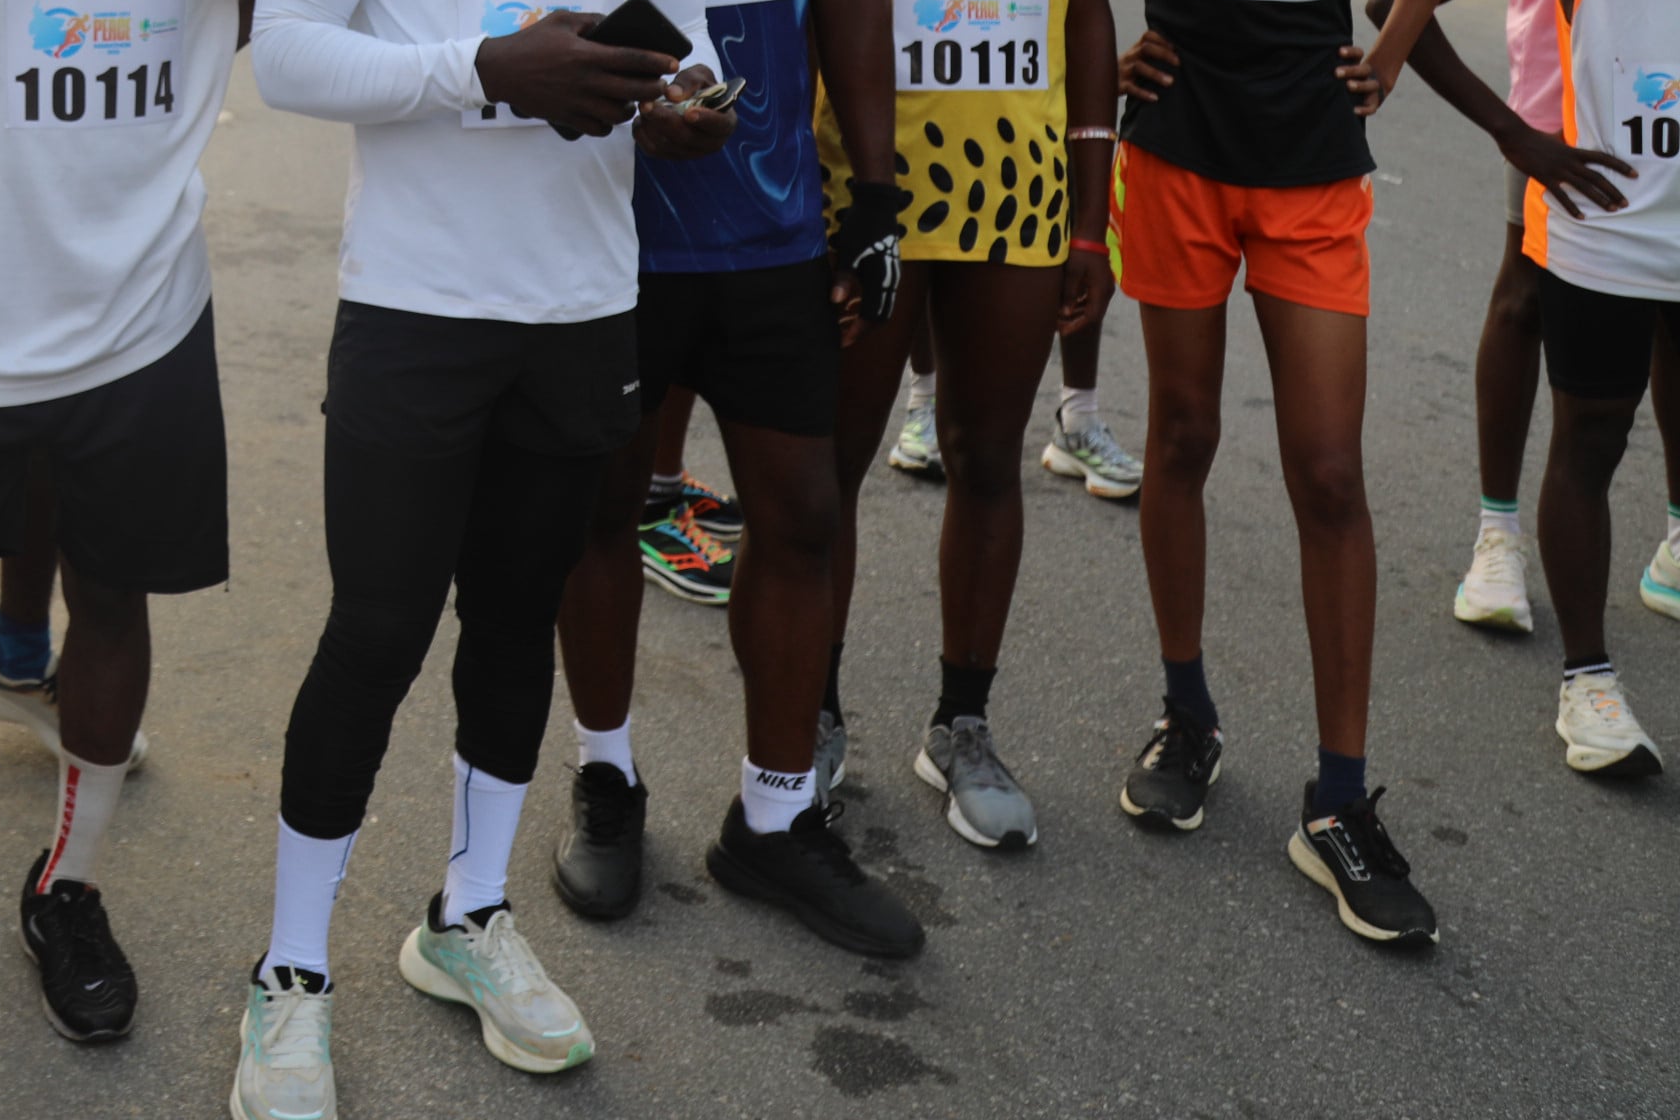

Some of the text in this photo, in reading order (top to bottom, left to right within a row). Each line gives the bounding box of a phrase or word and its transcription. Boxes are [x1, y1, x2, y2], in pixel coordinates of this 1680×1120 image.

[901, 40, 1039, 85] 10113
[15, 60, 174, 122] 10114
[756, 770, 807, 791] NIKE
